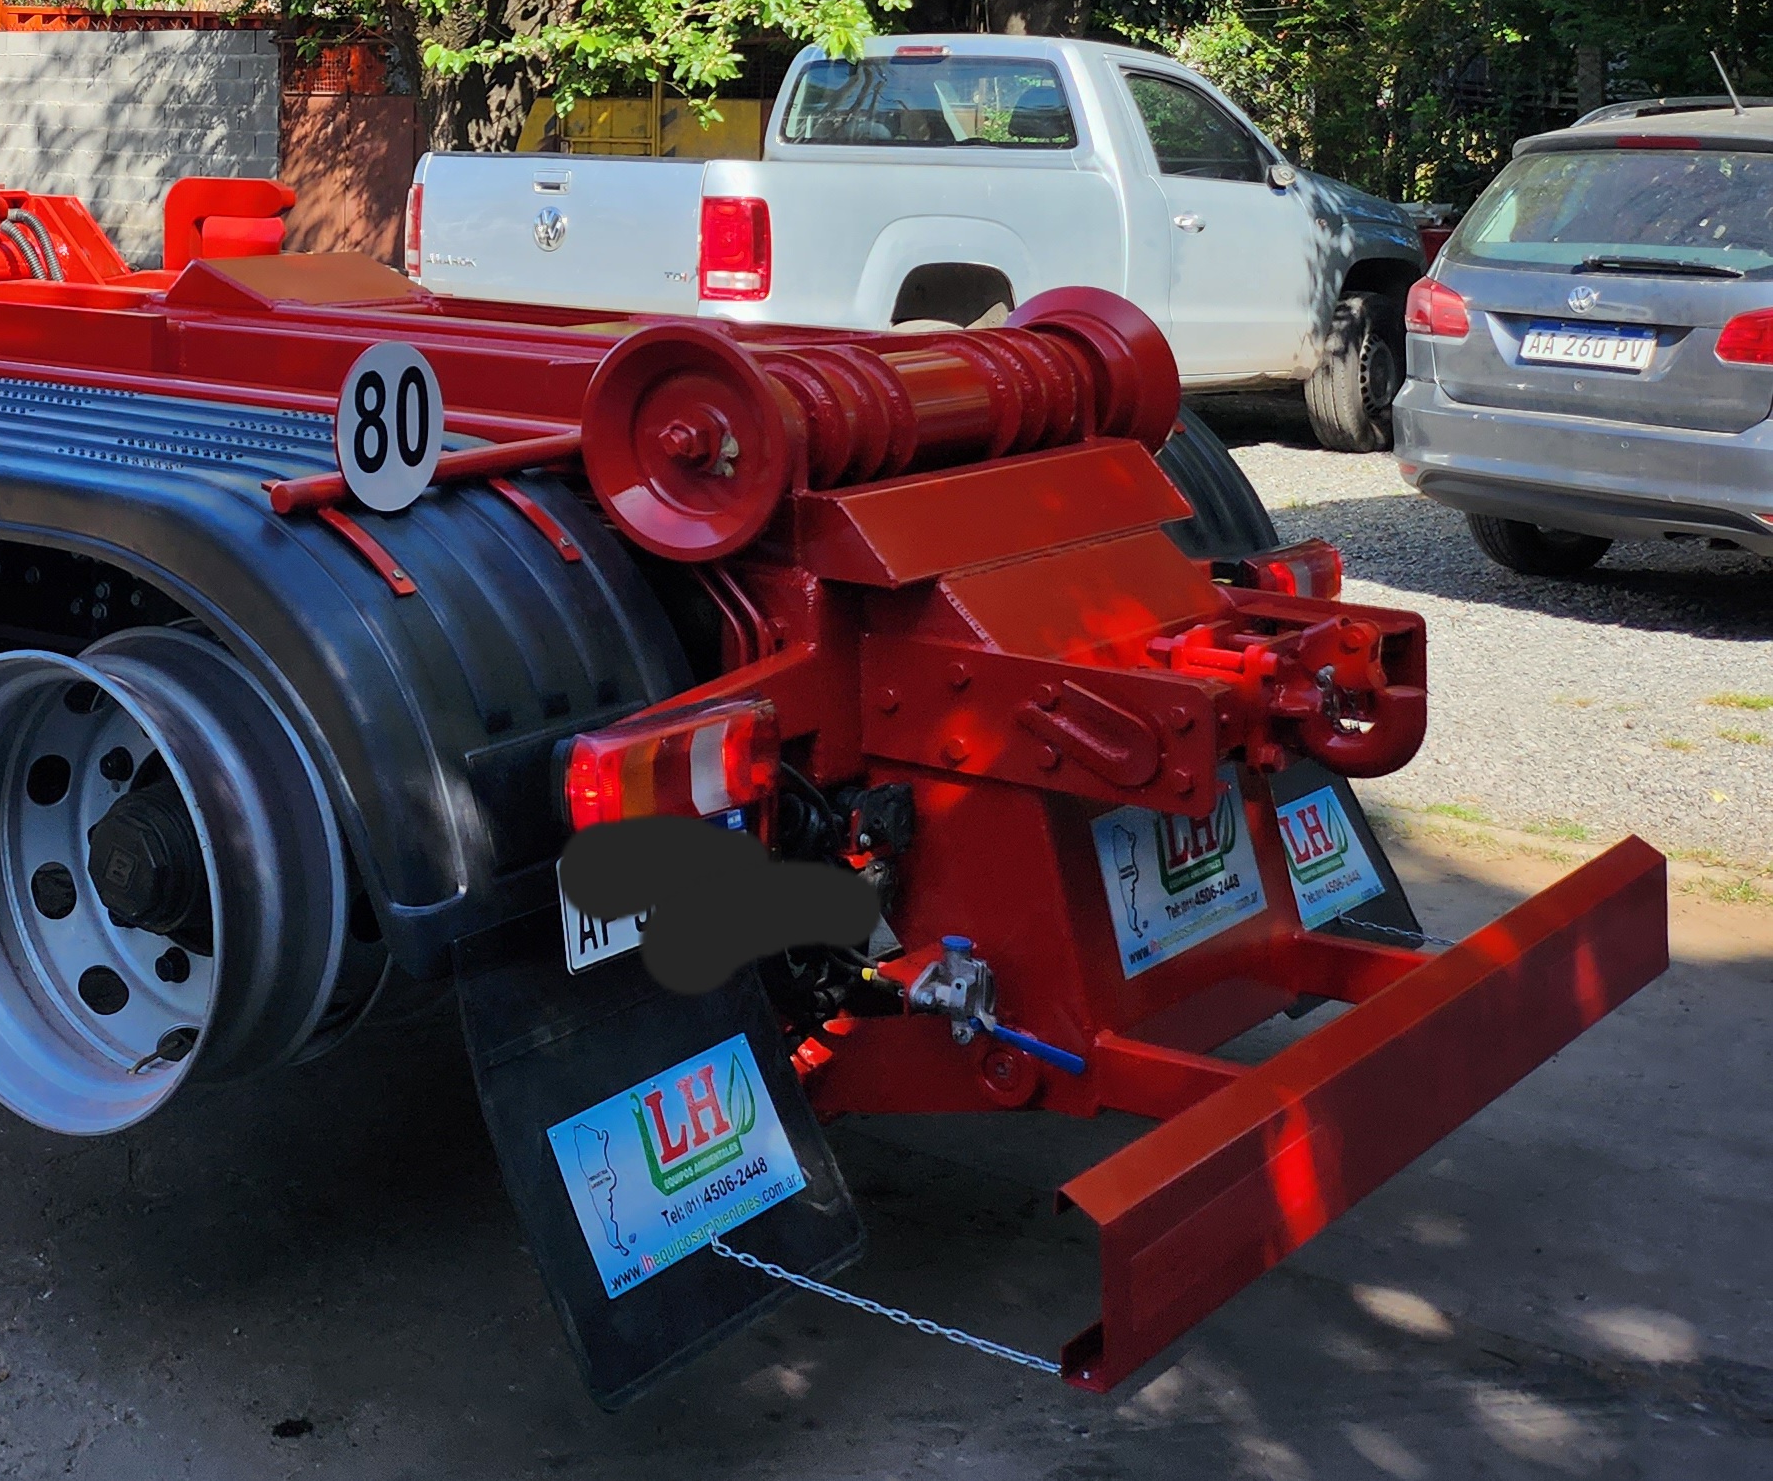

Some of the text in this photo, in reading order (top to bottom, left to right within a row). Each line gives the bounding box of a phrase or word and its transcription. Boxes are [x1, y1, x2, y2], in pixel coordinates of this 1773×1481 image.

[1528, 331, 1556, 354] AA
[1562, 334, 1607, 359] 260
[1612, 339, 1644, 362] PV
[353, 365, 429, 474] 80
[1278, 804, 1334, 865] LH
[643, 1064, 731, 1165] LH
